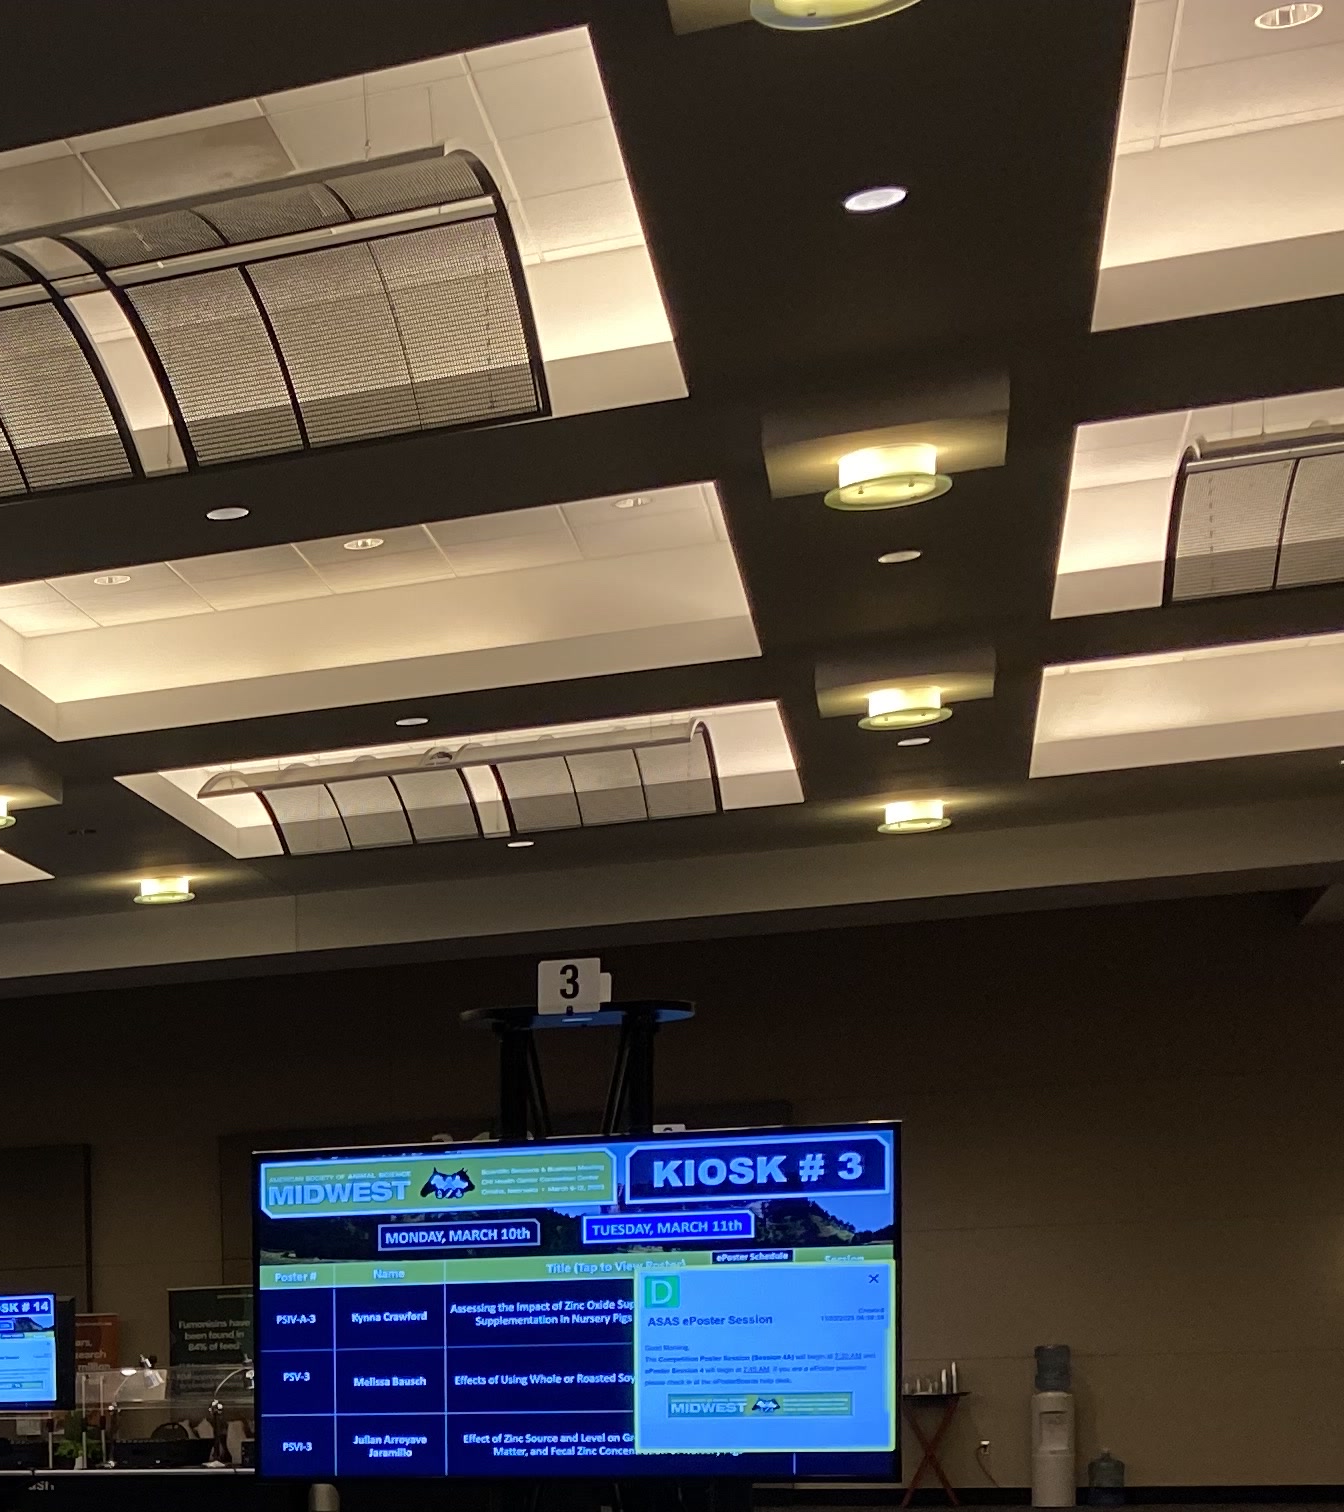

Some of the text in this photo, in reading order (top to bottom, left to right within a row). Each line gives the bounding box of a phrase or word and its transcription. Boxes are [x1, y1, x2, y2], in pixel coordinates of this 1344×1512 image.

[559, 964, 579, 999] 3
[653, 1152, 863, 1188] KIOSK # 3
[268, 1181, 411, 1205] MIDWEST
[592, 1219, 742, 1236] TUESDAY, MARCH 11th
[385, 1227, 531, 1245] MONDAY, MARCH 10th
[716, 1252, 789, 1262] ePoster Schedule
[824, 1254, 864, 1263] Session
[373, 1268, 405, 1279] Name
[547, 1263, 570, 1274] Title
[574, 1262, 597, 1275] (Tap
[600, 1262, 610, 1273] to
[275, 1271, 308, 1283] Poster
[651, 1281, 673, 1305] D
[21, 1301, 30, 1312] #
[33, 1301, 49, 1312] 14
[450, 1303, 496, 1315] Assessing
[498, 1303, 514, 1312] the
[516, 1302, 550, 1313] Impact
[552, 1301, 563, 1311] of
[564, 1300, 585, 1310] Zinc
[586, 1300, 614, 1310] Oxide
[276, 1314, 316, 1325] PSIV-A-3
[351, 1310, 428, 1323] Kynna Crawford
[475, 1314, 558, 1326] Supplementation
[571, 1313, 611, 1326] Nursery
[613, 1313, 632, 1325] Pigs
[648, 1314, 773, 1326] ASAS ePoster Session
[229, 1319, 250, 1328] have
[185, 1332, 207, 1340] been
[208, 1330, 235, 1339] found
[283, 1372, 310, 1382] PSV-3
[353, 1376, 426, 1387] Melissa Bausch
[454, 1375, 486, 1385] Effects
[488, 1375, 499, 1384] of
[501, 1374, 528, 1386] Using
[530, 1374, 562, 1384] Whole
[564, 1376, 575, 1384] or
[576, 1373, 616, 1384] Roasted
[671, 1402, 747, 1414] MIDWEST
[353, 1434, 428, 1446] Julian Arroyave
[463, 1433, 621, 1444] Effect of Zinc Source and Level on
[283, 1442, 312, 1452] PSVI-3
[368, 1448, 412, 1458] Jaramillo
[493, 1446, 528, 1457] Matter,
[530, 1446, 549, 1456] and
[550, 1445, 575, 1456] Fecal
[577, 1445, 597, 1455] Zinc
